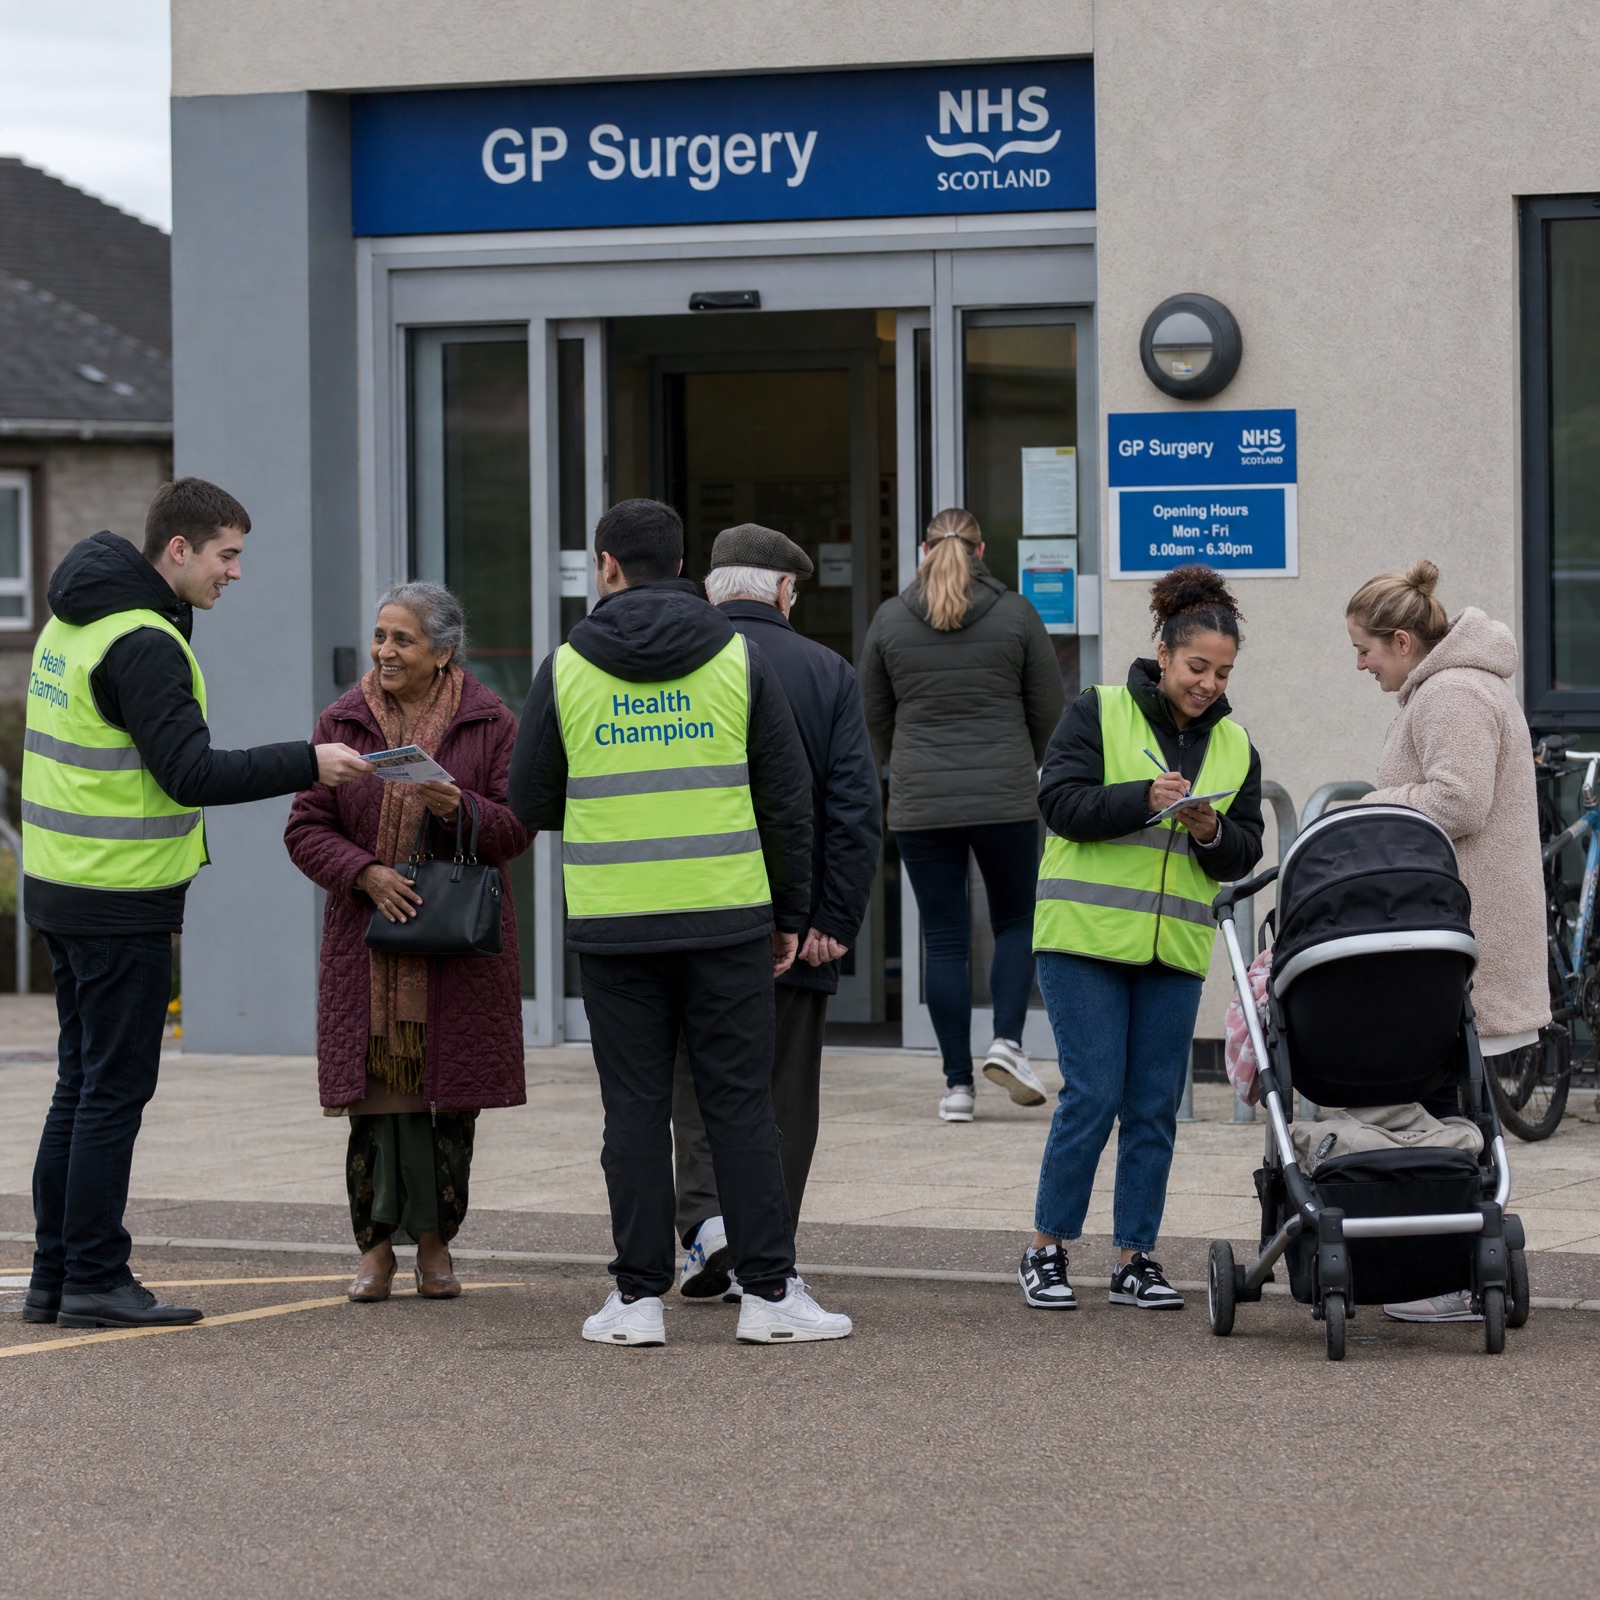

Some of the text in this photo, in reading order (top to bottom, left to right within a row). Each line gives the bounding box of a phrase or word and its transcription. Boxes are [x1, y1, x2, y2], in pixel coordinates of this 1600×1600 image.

[938, 86, 1050, 135] NHS
[481, 124, 818, 191] GP Surgery
[936, 168, 1051, 191] SCOTLAND
[1241, 428, 1282, 446] NHS
[1118, 439, 1214, 459] GP Surgery
[1241, 456, 1283, 465] SCOTLAND
[1152, 503, 1249, 520] Opening Hours
[1172, 524, 1200, 538] Mon
[1211, 524, 1230, 538] Fri
[1149, 543, 1195, 557] 8.00am
[1206, 542, 1253, 558] 6.30pm
[39, 648, 66, 678] Health
[29, 671, 68, 710] Champion
[612, 689, 691, 717] Health
[594, 717, 714, 746] Champion
